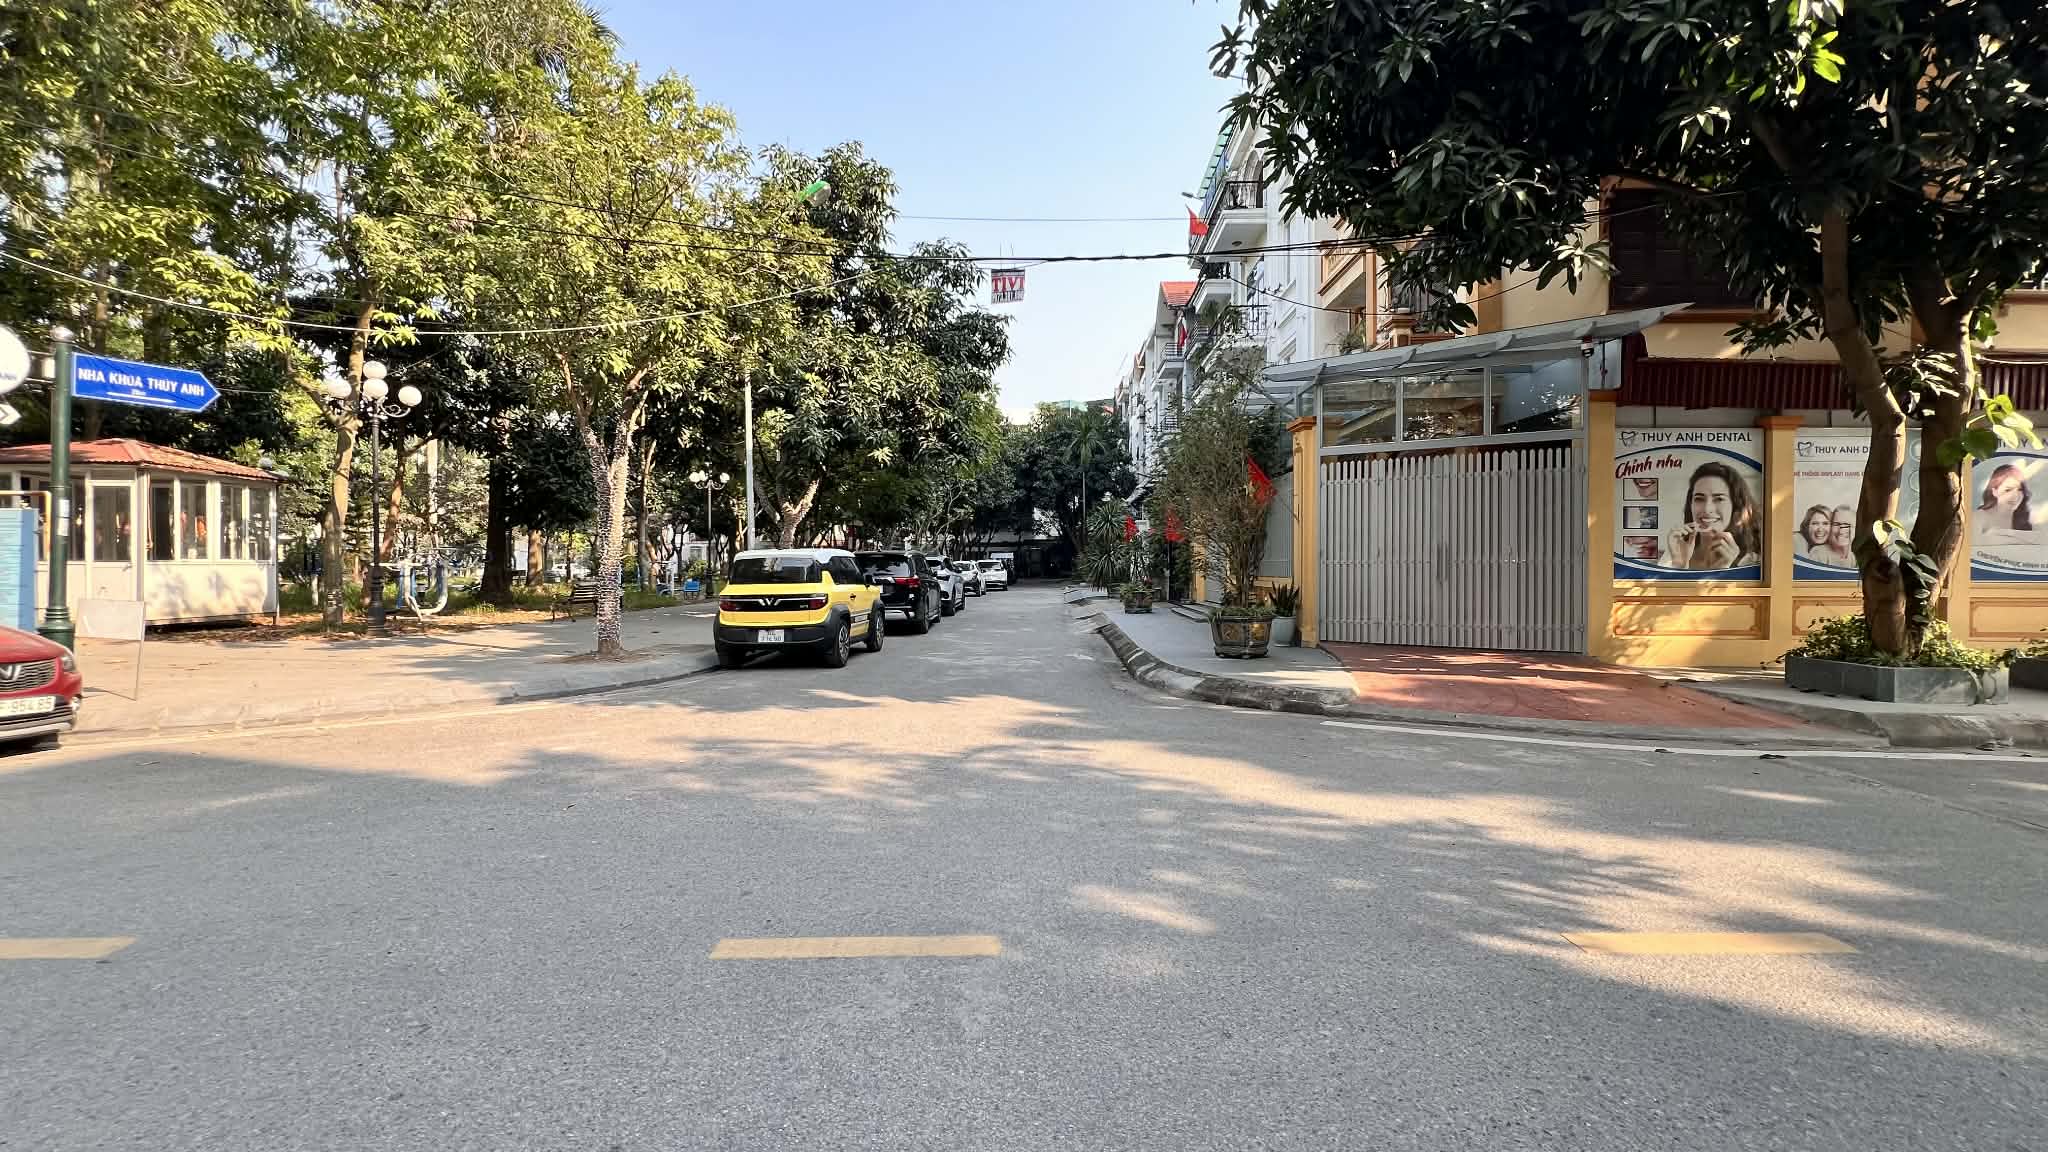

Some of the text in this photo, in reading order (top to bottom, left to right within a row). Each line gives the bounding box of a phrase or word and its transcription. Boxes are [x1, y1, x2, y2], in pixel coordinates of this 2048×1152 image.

[78, 368, 105, 383] NHA
[180, 383, 206, 397] ANH
[1641, 432, 1753, 442] THUY ANH DENTAL
[1815, 446, 1837, 454] THUY
[1840, 446, 1859, 454] ANH
[1656, 454, 1682, 469] nha
